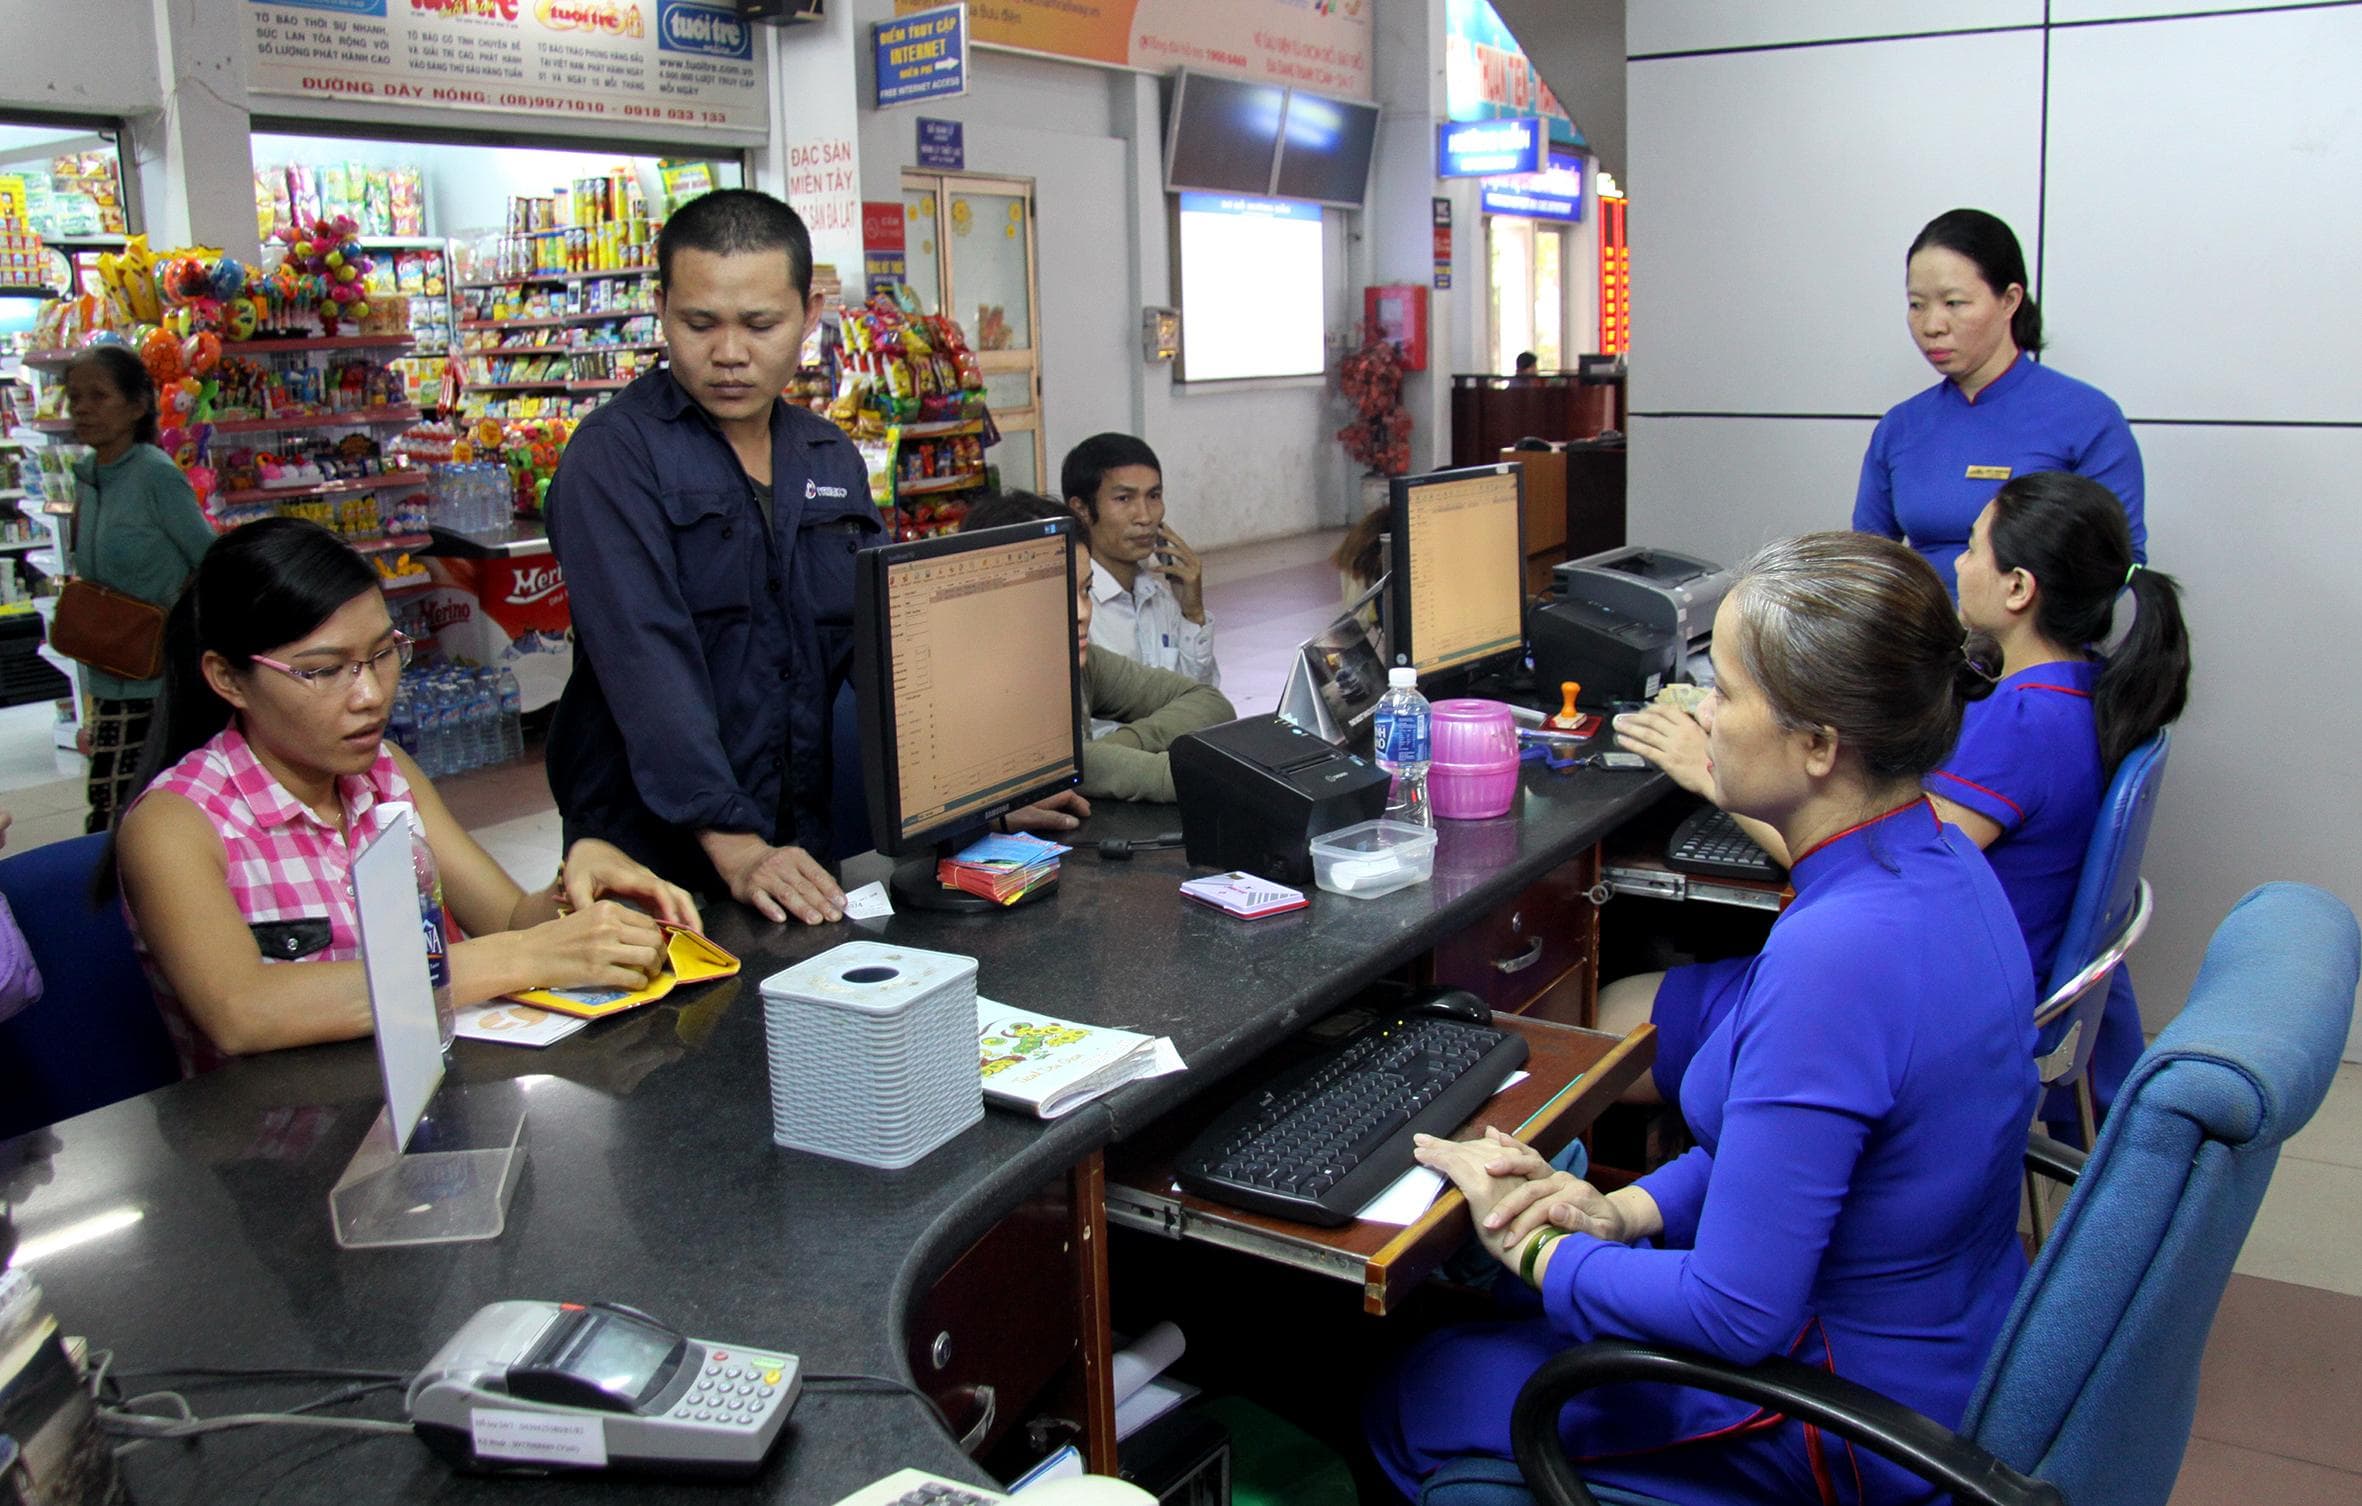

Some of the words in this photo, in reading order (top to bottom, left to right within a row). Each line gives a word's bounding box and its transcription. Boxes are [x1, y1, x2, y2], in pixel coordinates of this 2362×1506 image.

[285, 29, 306, 41] LAN
[371, 54, 391, 65] CAO
[890, 38, 946, 66] INTERNET
[302, 76, 375, 95] ĐƯỜNG
[384, 82, 424, 98] DÂY
[500, 94, 604, 113] (08)9971010
[624, 105, 661, 118] 0918
[668, 109, 694, 120] 033
[702, 111, 727, 123] 133
